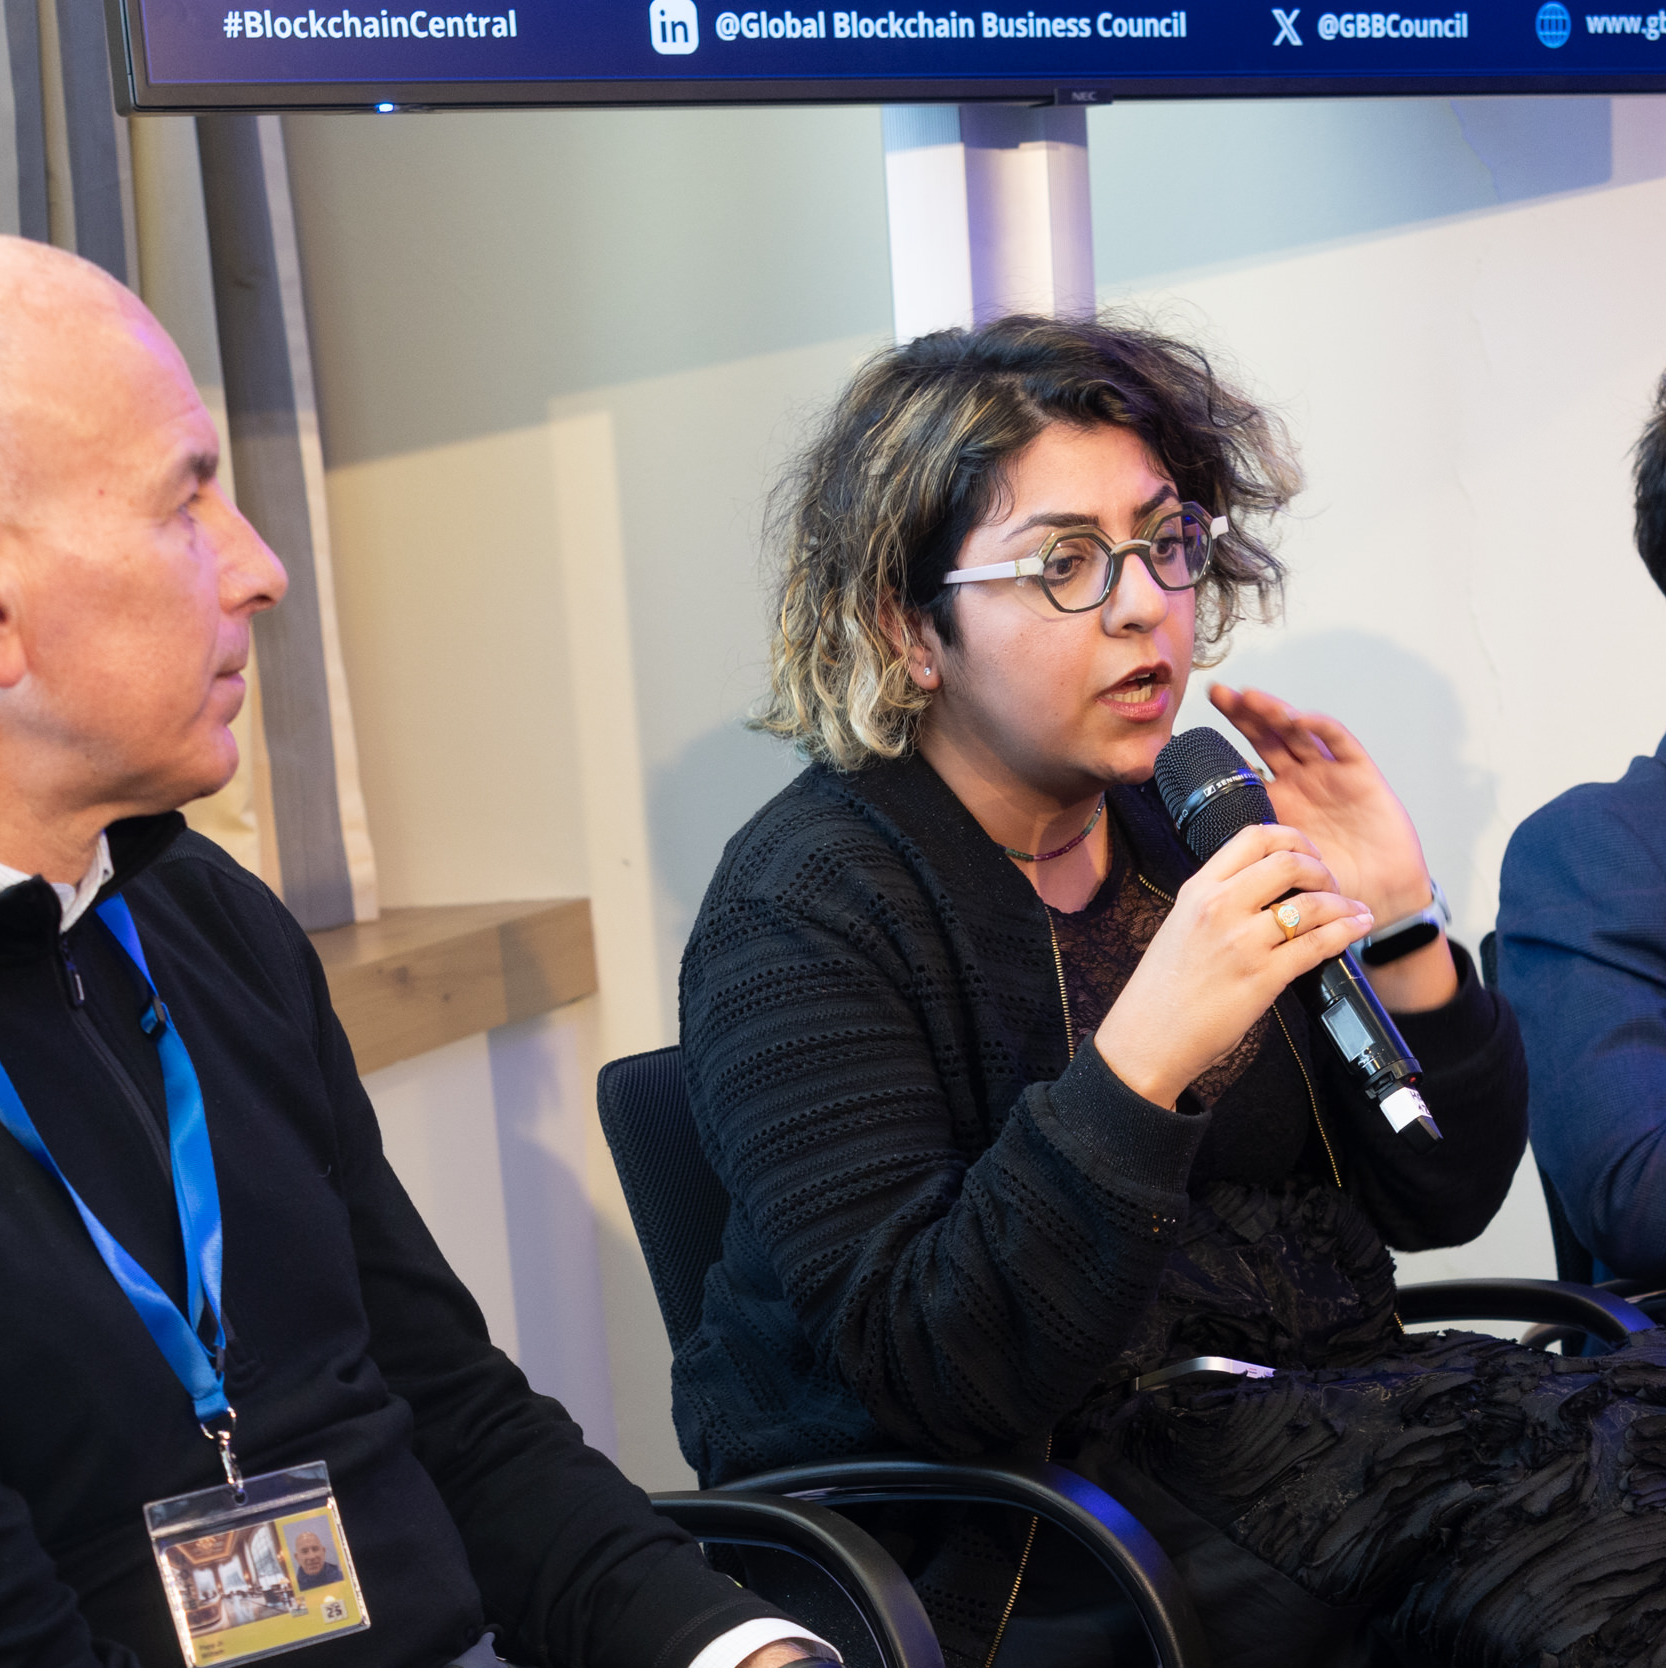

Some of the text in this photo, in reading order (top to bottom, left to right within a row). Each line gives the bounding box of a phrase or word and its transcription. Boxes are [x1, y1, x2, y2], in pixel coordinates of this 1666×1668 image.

[223, 9, 518, 39] #BlockchainCentral
[715, 10, 1187, 41] @Global Blockchain Business Council
[1317, 11, 1469, 40] @GBBCouncil
[1071, 90, 1098, 102] NEC
